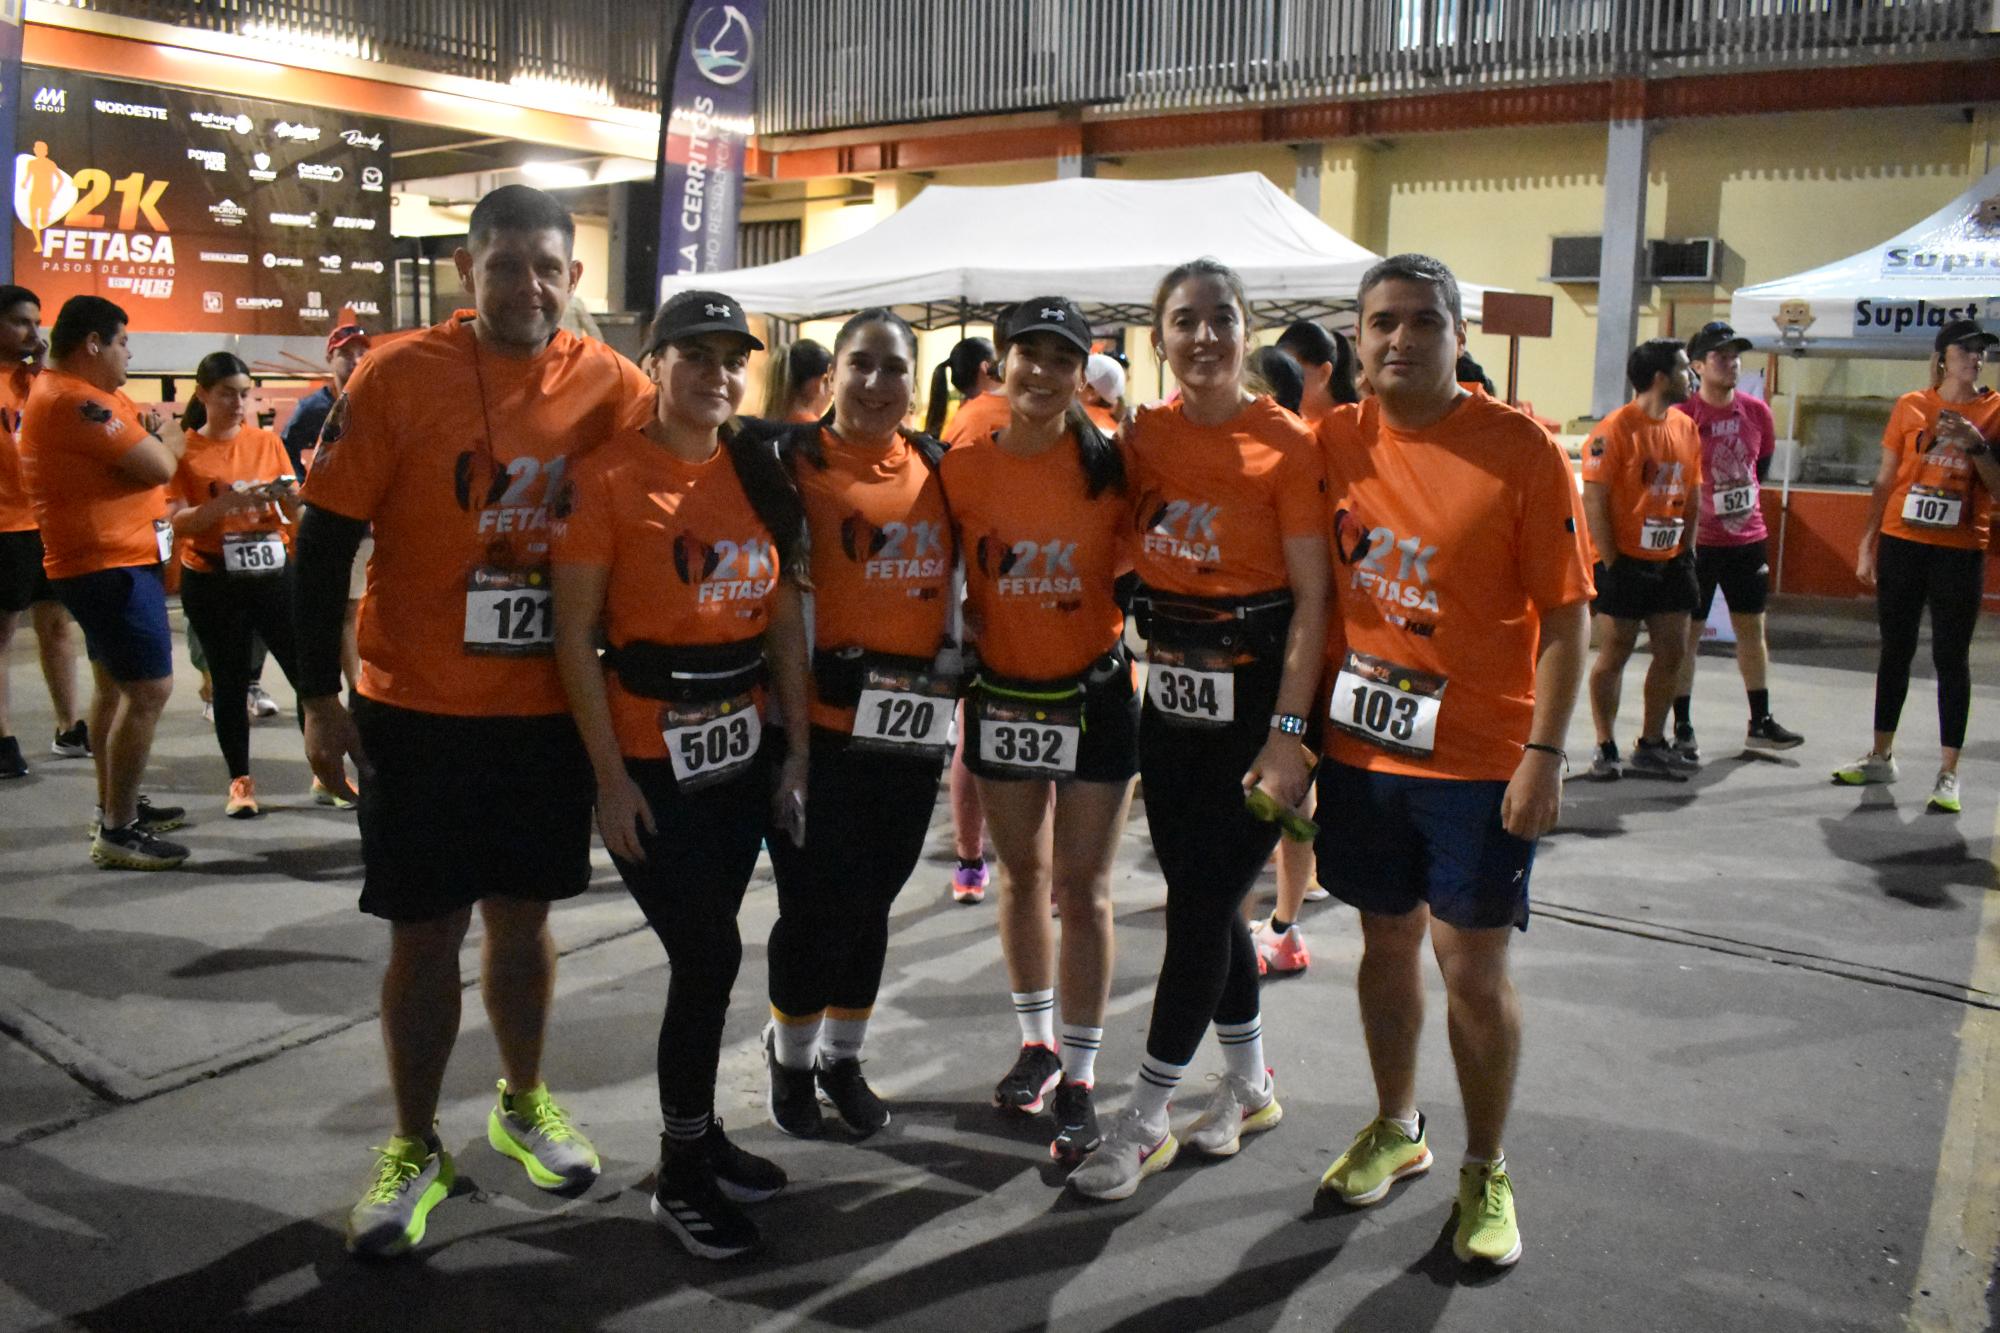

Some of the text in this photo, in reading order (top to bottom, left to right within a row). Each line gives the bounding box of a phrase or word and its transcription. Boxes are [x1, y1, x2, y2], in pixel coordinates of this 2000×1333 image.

[35, 104, 65, 113] GROUP
[95, 100, 167, 120] NOROESTE
[682, 96, 713, 231] CERRITOS
[64, 168, 169, 231] 21K
[43, 229, 175, 264] FETASA
[42, 262, 176, 277] PASOS DE ACERO
[1856, 299, 1978, 333] Suplast
[1723, 489, 1751, 512] 521
[1915, 498, 1949, 521] 107
[235, 544, 275, 569] 158
[879, 519, 944, 559] 21K
[1143, 535, 1222, 563] FETASA
[1358, 526, 1439, 584] 21K
[866, 558, 944, 580] FETASA
[1010, 537, 1079, 577] 21K
[998, 577, 1082, 595] FETASA
[1160, 670, 1219, 716] 334
[877, 698, 935, 739] 120
[1352, 684, 1419, 741] 103
[680, 716, 750, 771] 503
[995, 725, 1063, 766] 332
